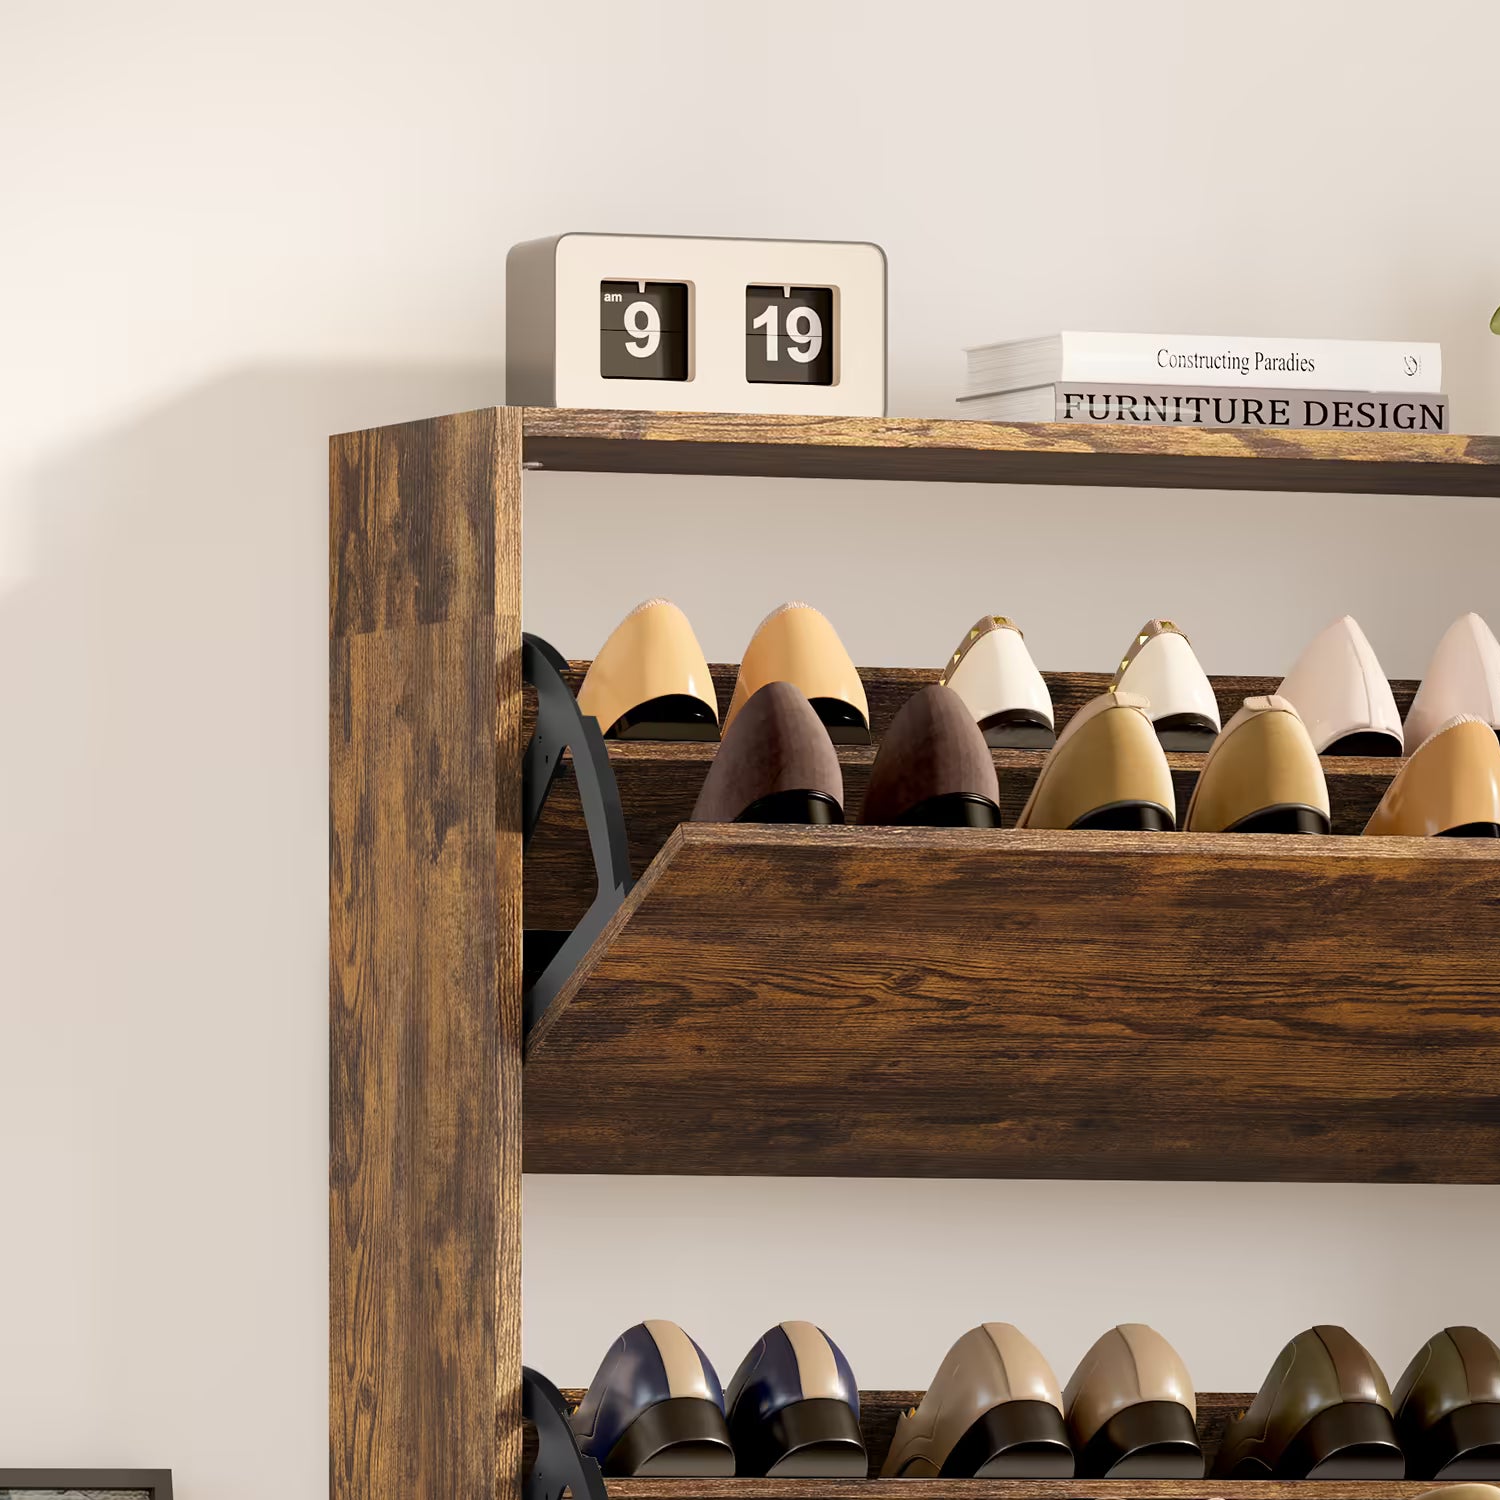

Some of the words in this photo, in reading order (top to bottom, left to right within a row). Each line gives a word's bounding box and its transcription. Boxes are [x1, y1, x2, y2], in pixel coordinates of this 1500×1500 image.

[603, 293, 623, 302] am
[623, 301, 661, 358] 9
[752, 305, 823, 363] 19
[1157, 349, 1250, 375] Constructing
[1255, 351, 1315, 372] Paradies
[1063, 393, 1290, 425] FURNITURE
[1303, 400, 1445, 430] DESIGN
